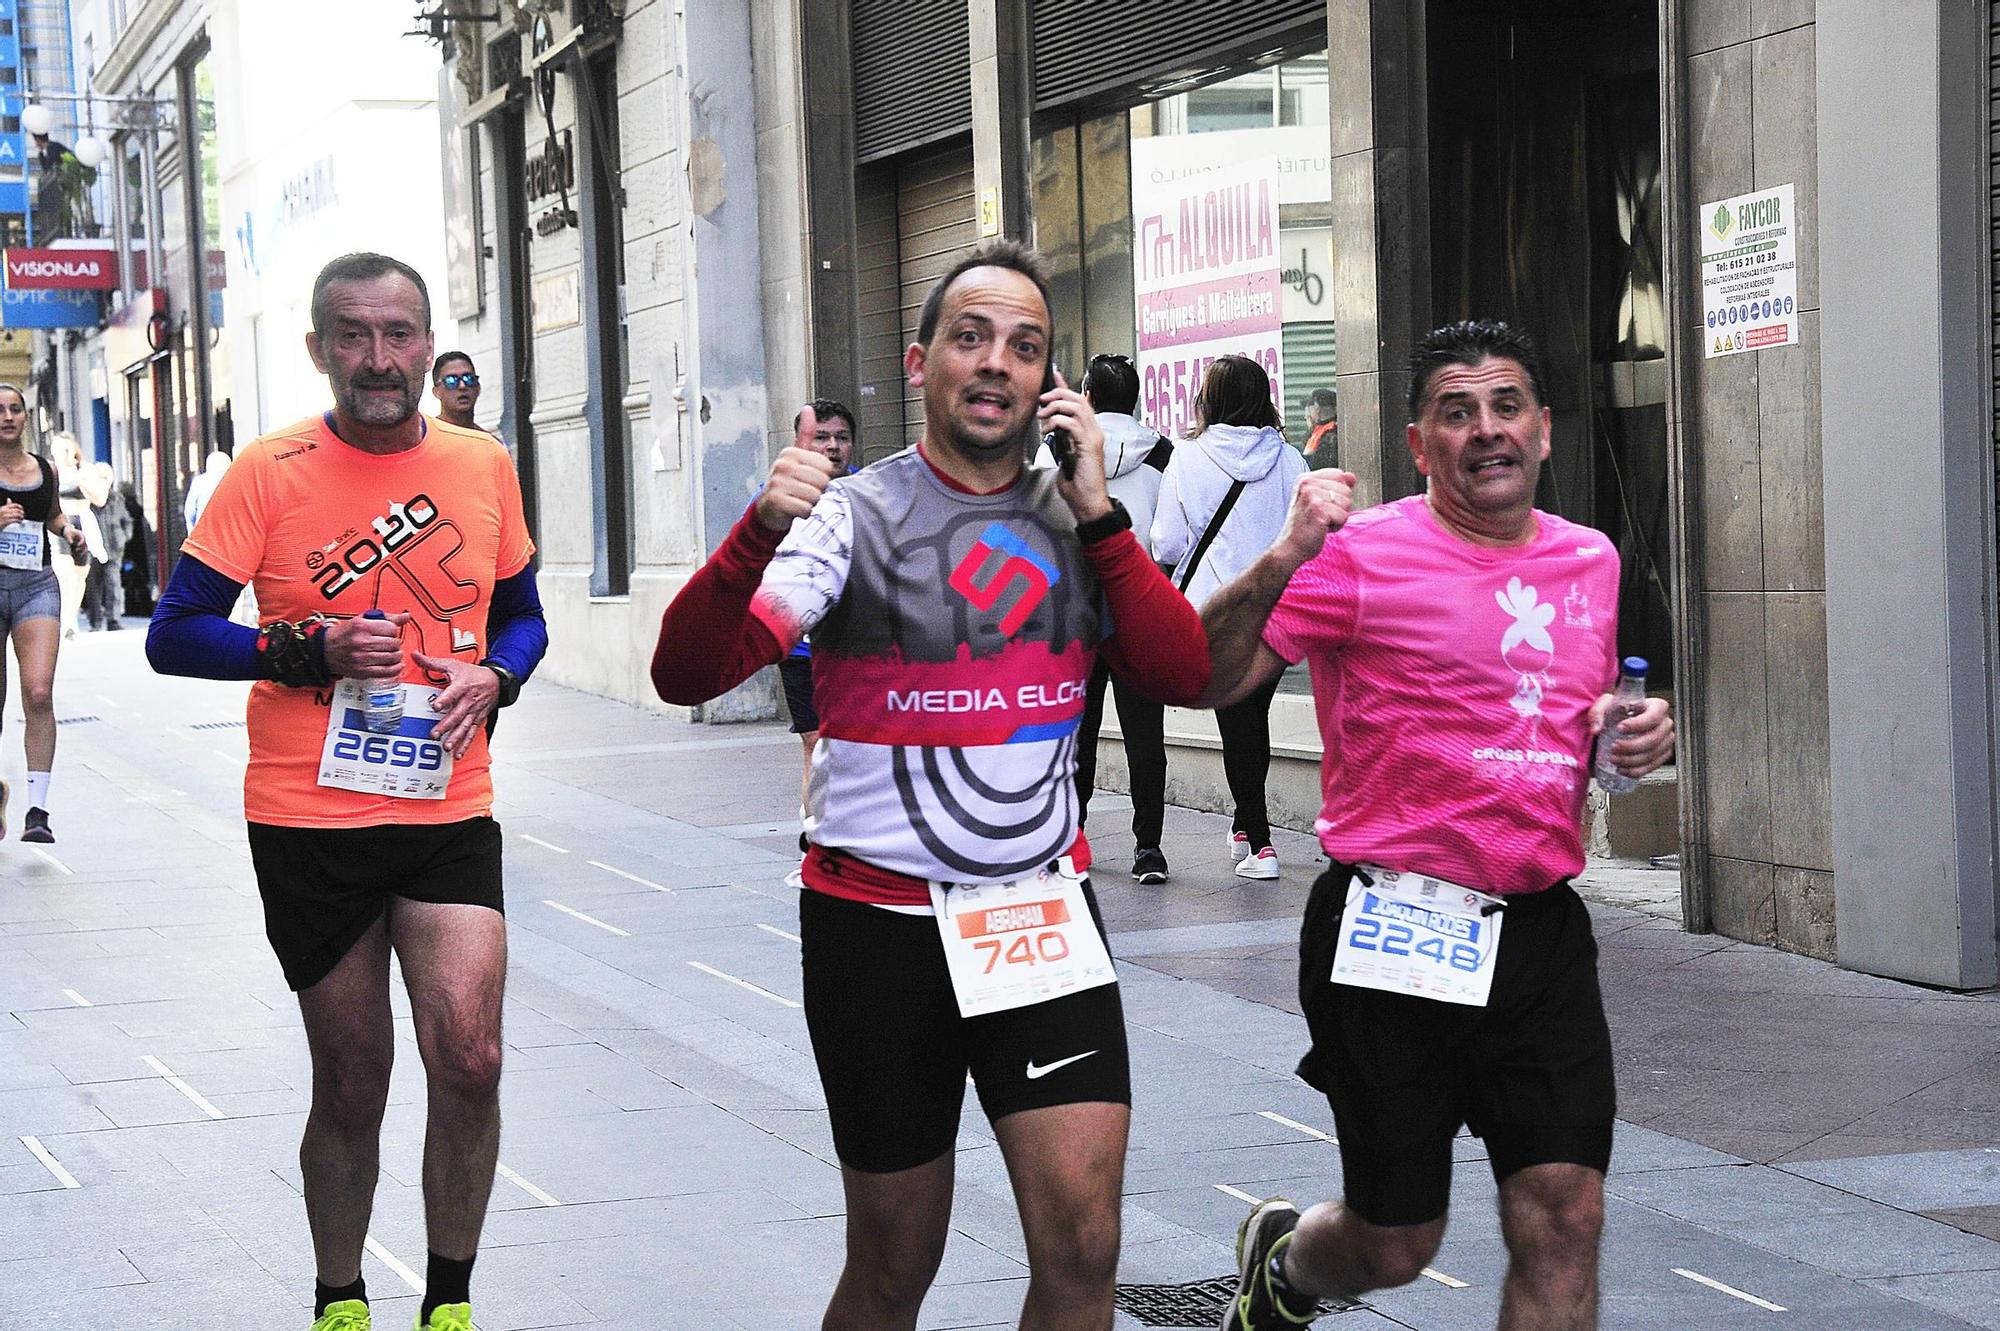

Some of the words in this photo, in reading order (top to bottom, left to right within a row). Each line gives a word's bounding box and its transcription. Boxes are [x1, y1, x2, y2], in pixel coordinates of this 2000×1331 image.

[1179, 178, 1273, 274] ALQUILA
[1739, 197, 1781, 231] FAYCOR
[9, 261, 100, 277] VISIONLAB
[1716, 263, 1728, 273] Tel:
[1730, 258, 1743, 270] 615
[1745, 257, 1754, 266] 21
[1756, 254, 1766, 263] 02
[1767, 251, 1777, 261] 38
[1142, 301, 1195, 336] Garrigues
[1197, 294, 1206, 326] &
[0, 541, 36, 556] 2124
[887, 689, 1008, 713] MEDIA
[1017, 680, 1087, 708] ELCH
[333, 731, 442, 771] 2699
[1472, 747, 1525, 762] CROSS
[974, 931, 1070, 975] 740
[1349, 917, 1481, 973] 2248
